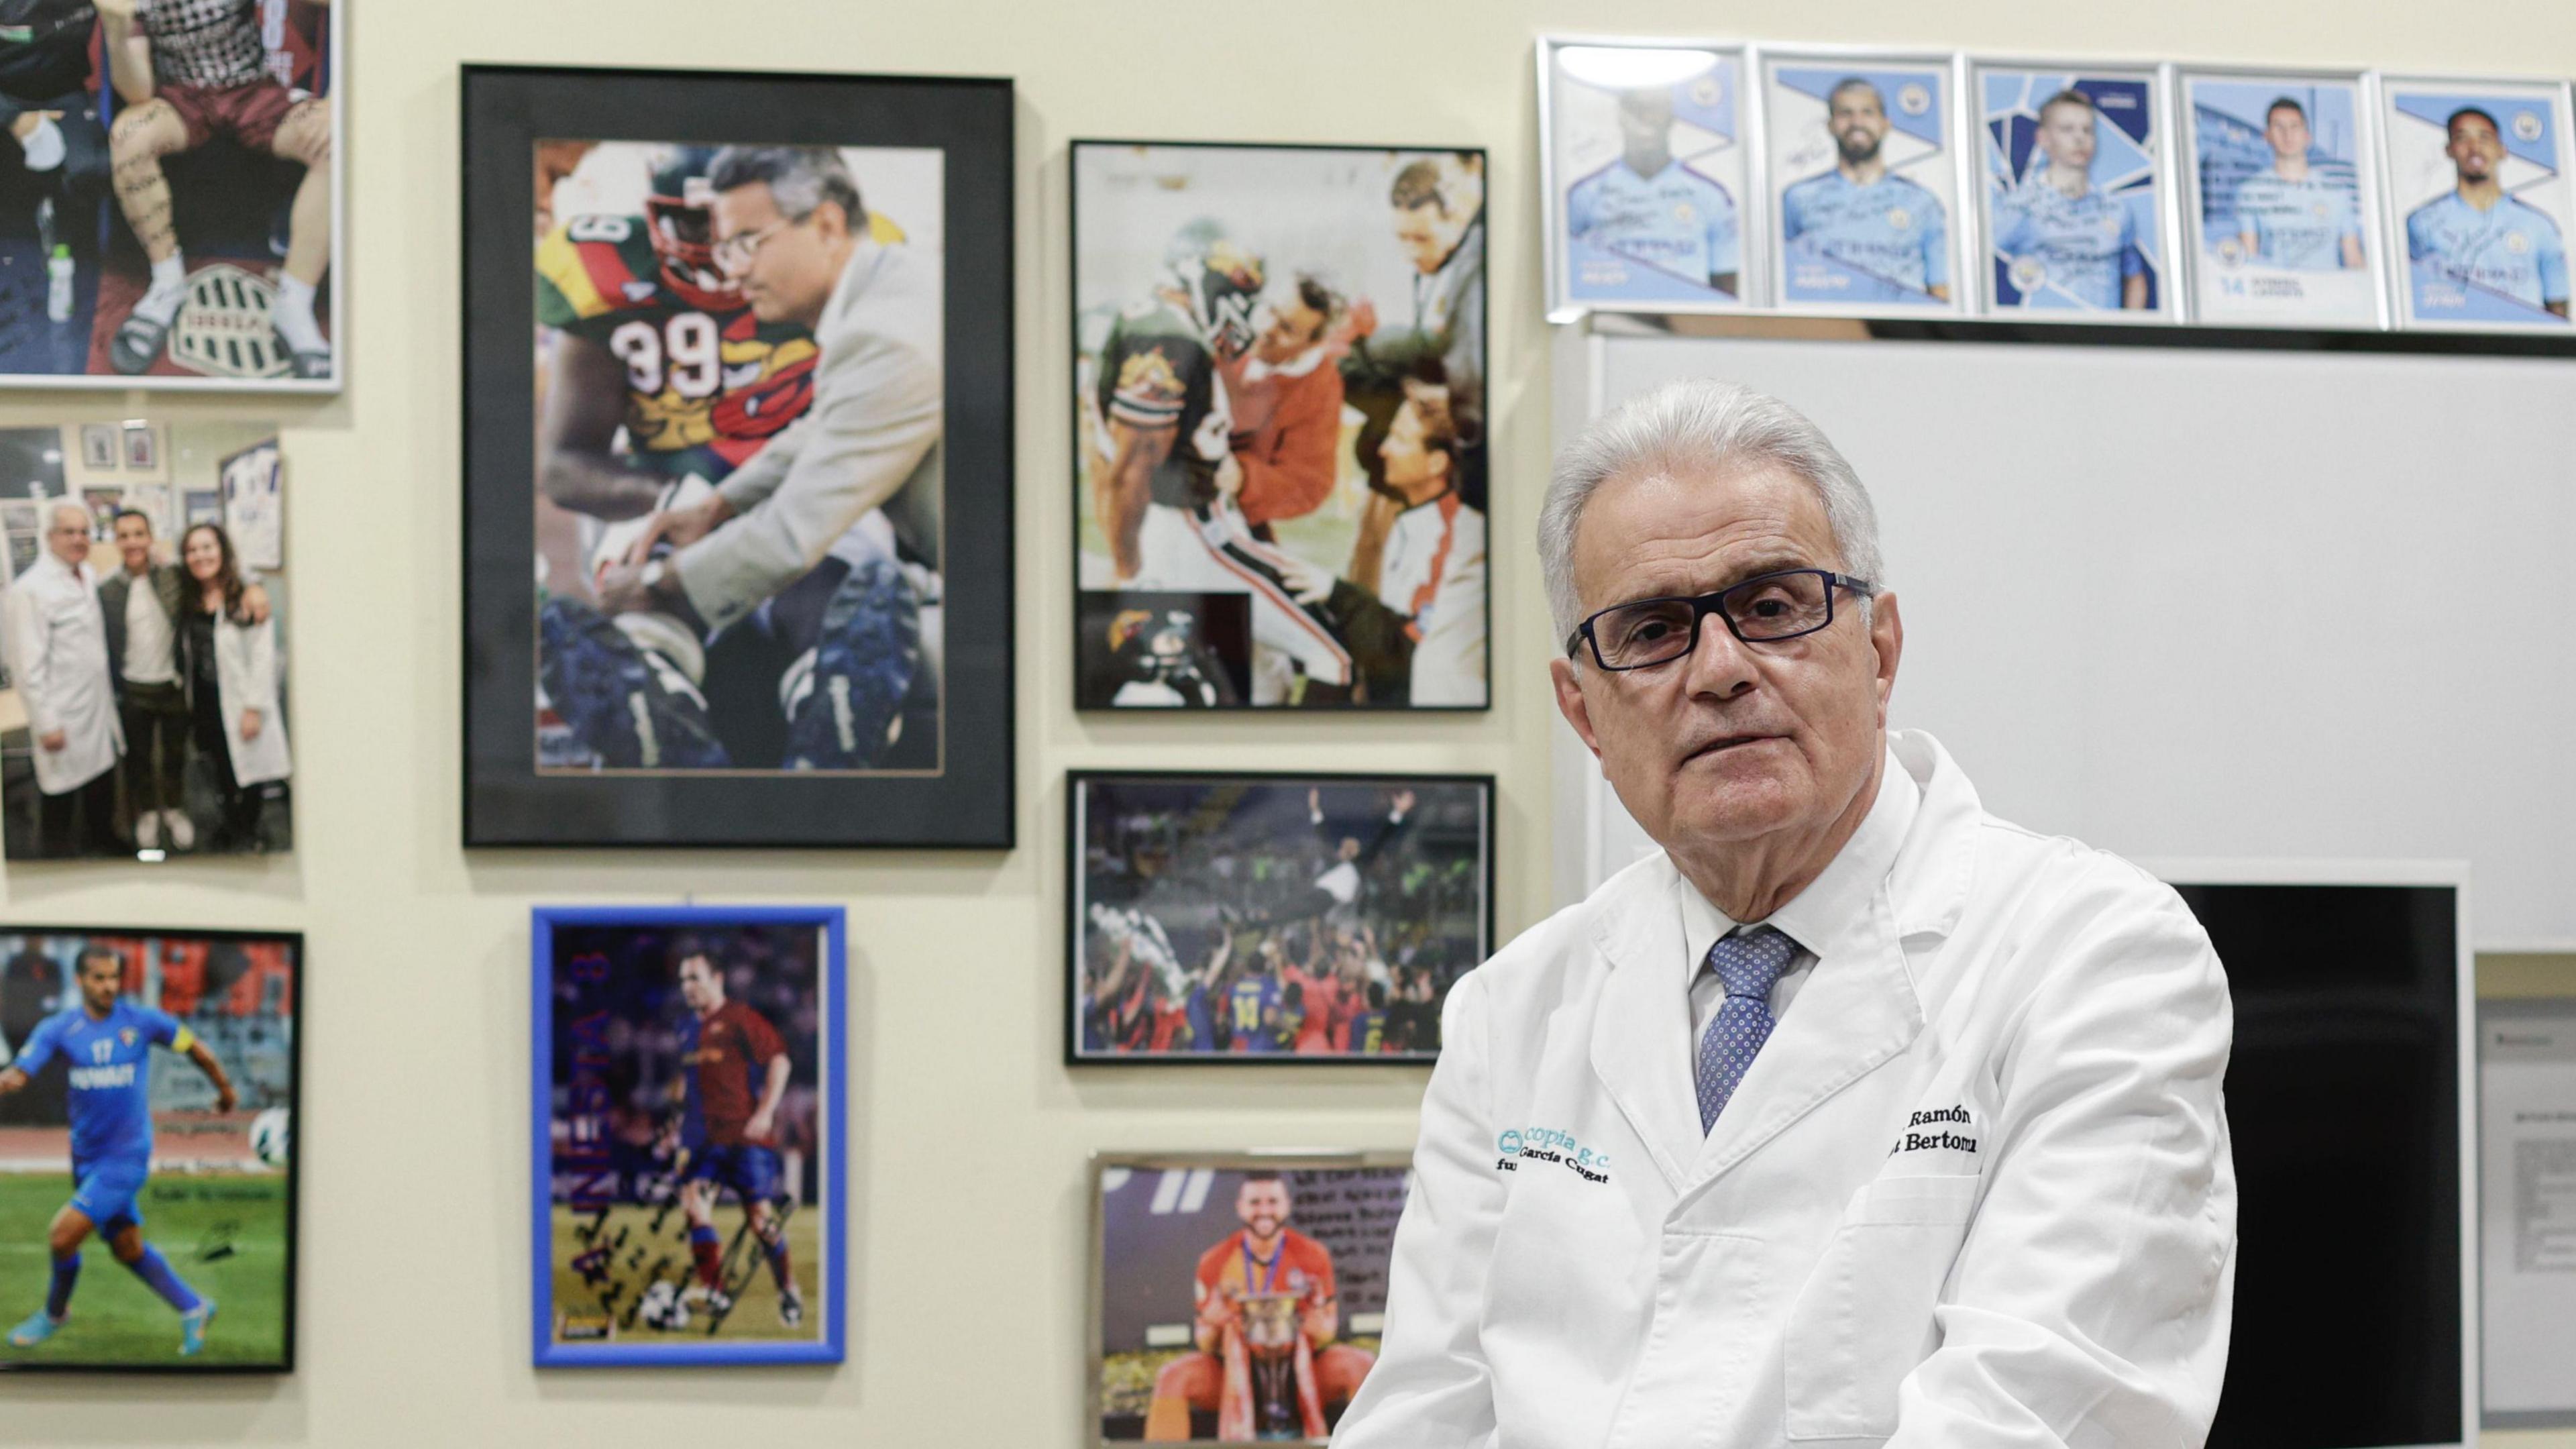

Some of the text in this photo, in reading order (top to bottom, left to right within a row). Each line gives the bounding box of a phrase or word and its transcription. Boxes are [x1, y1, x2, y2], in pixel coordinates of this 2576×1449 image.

[1908, 1104, 1971, 1128] Ramón
[1519, 1146, 1561, 1163] García
[1565, 1157, 1609, 1184] Cugat
